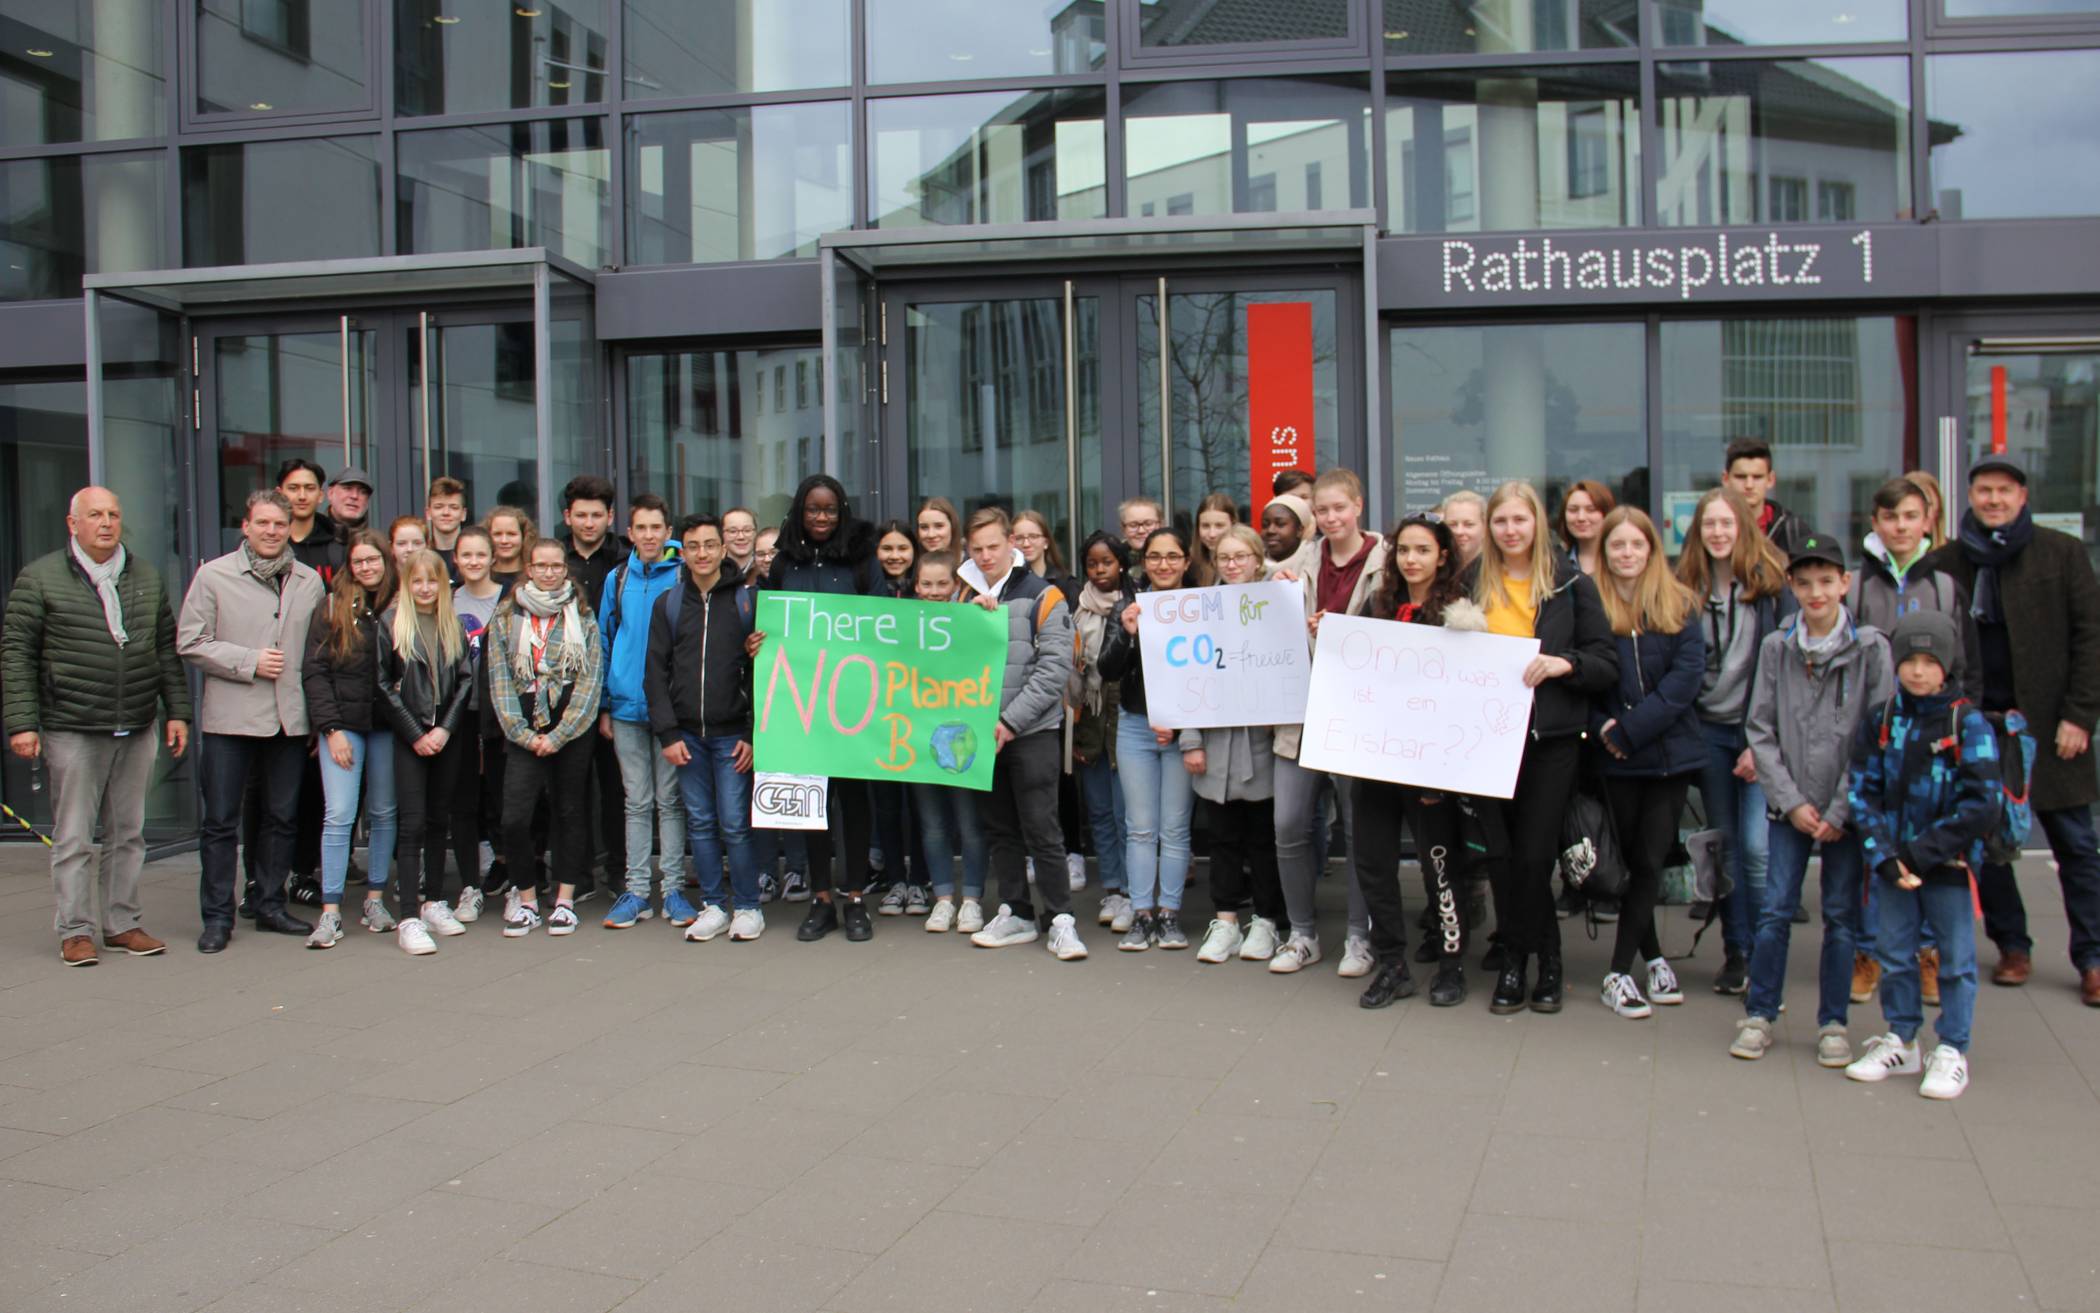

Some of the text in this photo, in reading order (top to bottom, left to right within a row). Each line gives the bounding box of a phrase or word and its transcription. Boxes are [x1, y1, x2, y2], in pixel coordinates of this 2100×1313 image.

[1442, 230, 1873, 299] Rathausplatz 1
[767, 595, 952, 650] There is
[1153, 592, 1269, 626] GGM für
[759, 644, 995, 736] NO Planet
[1352, 685, 1376, 704] ist
[1457, 669, 1501, 688] was
[875, 713, 916, 772] B
[1439, 888, 1461, 953] adidas
